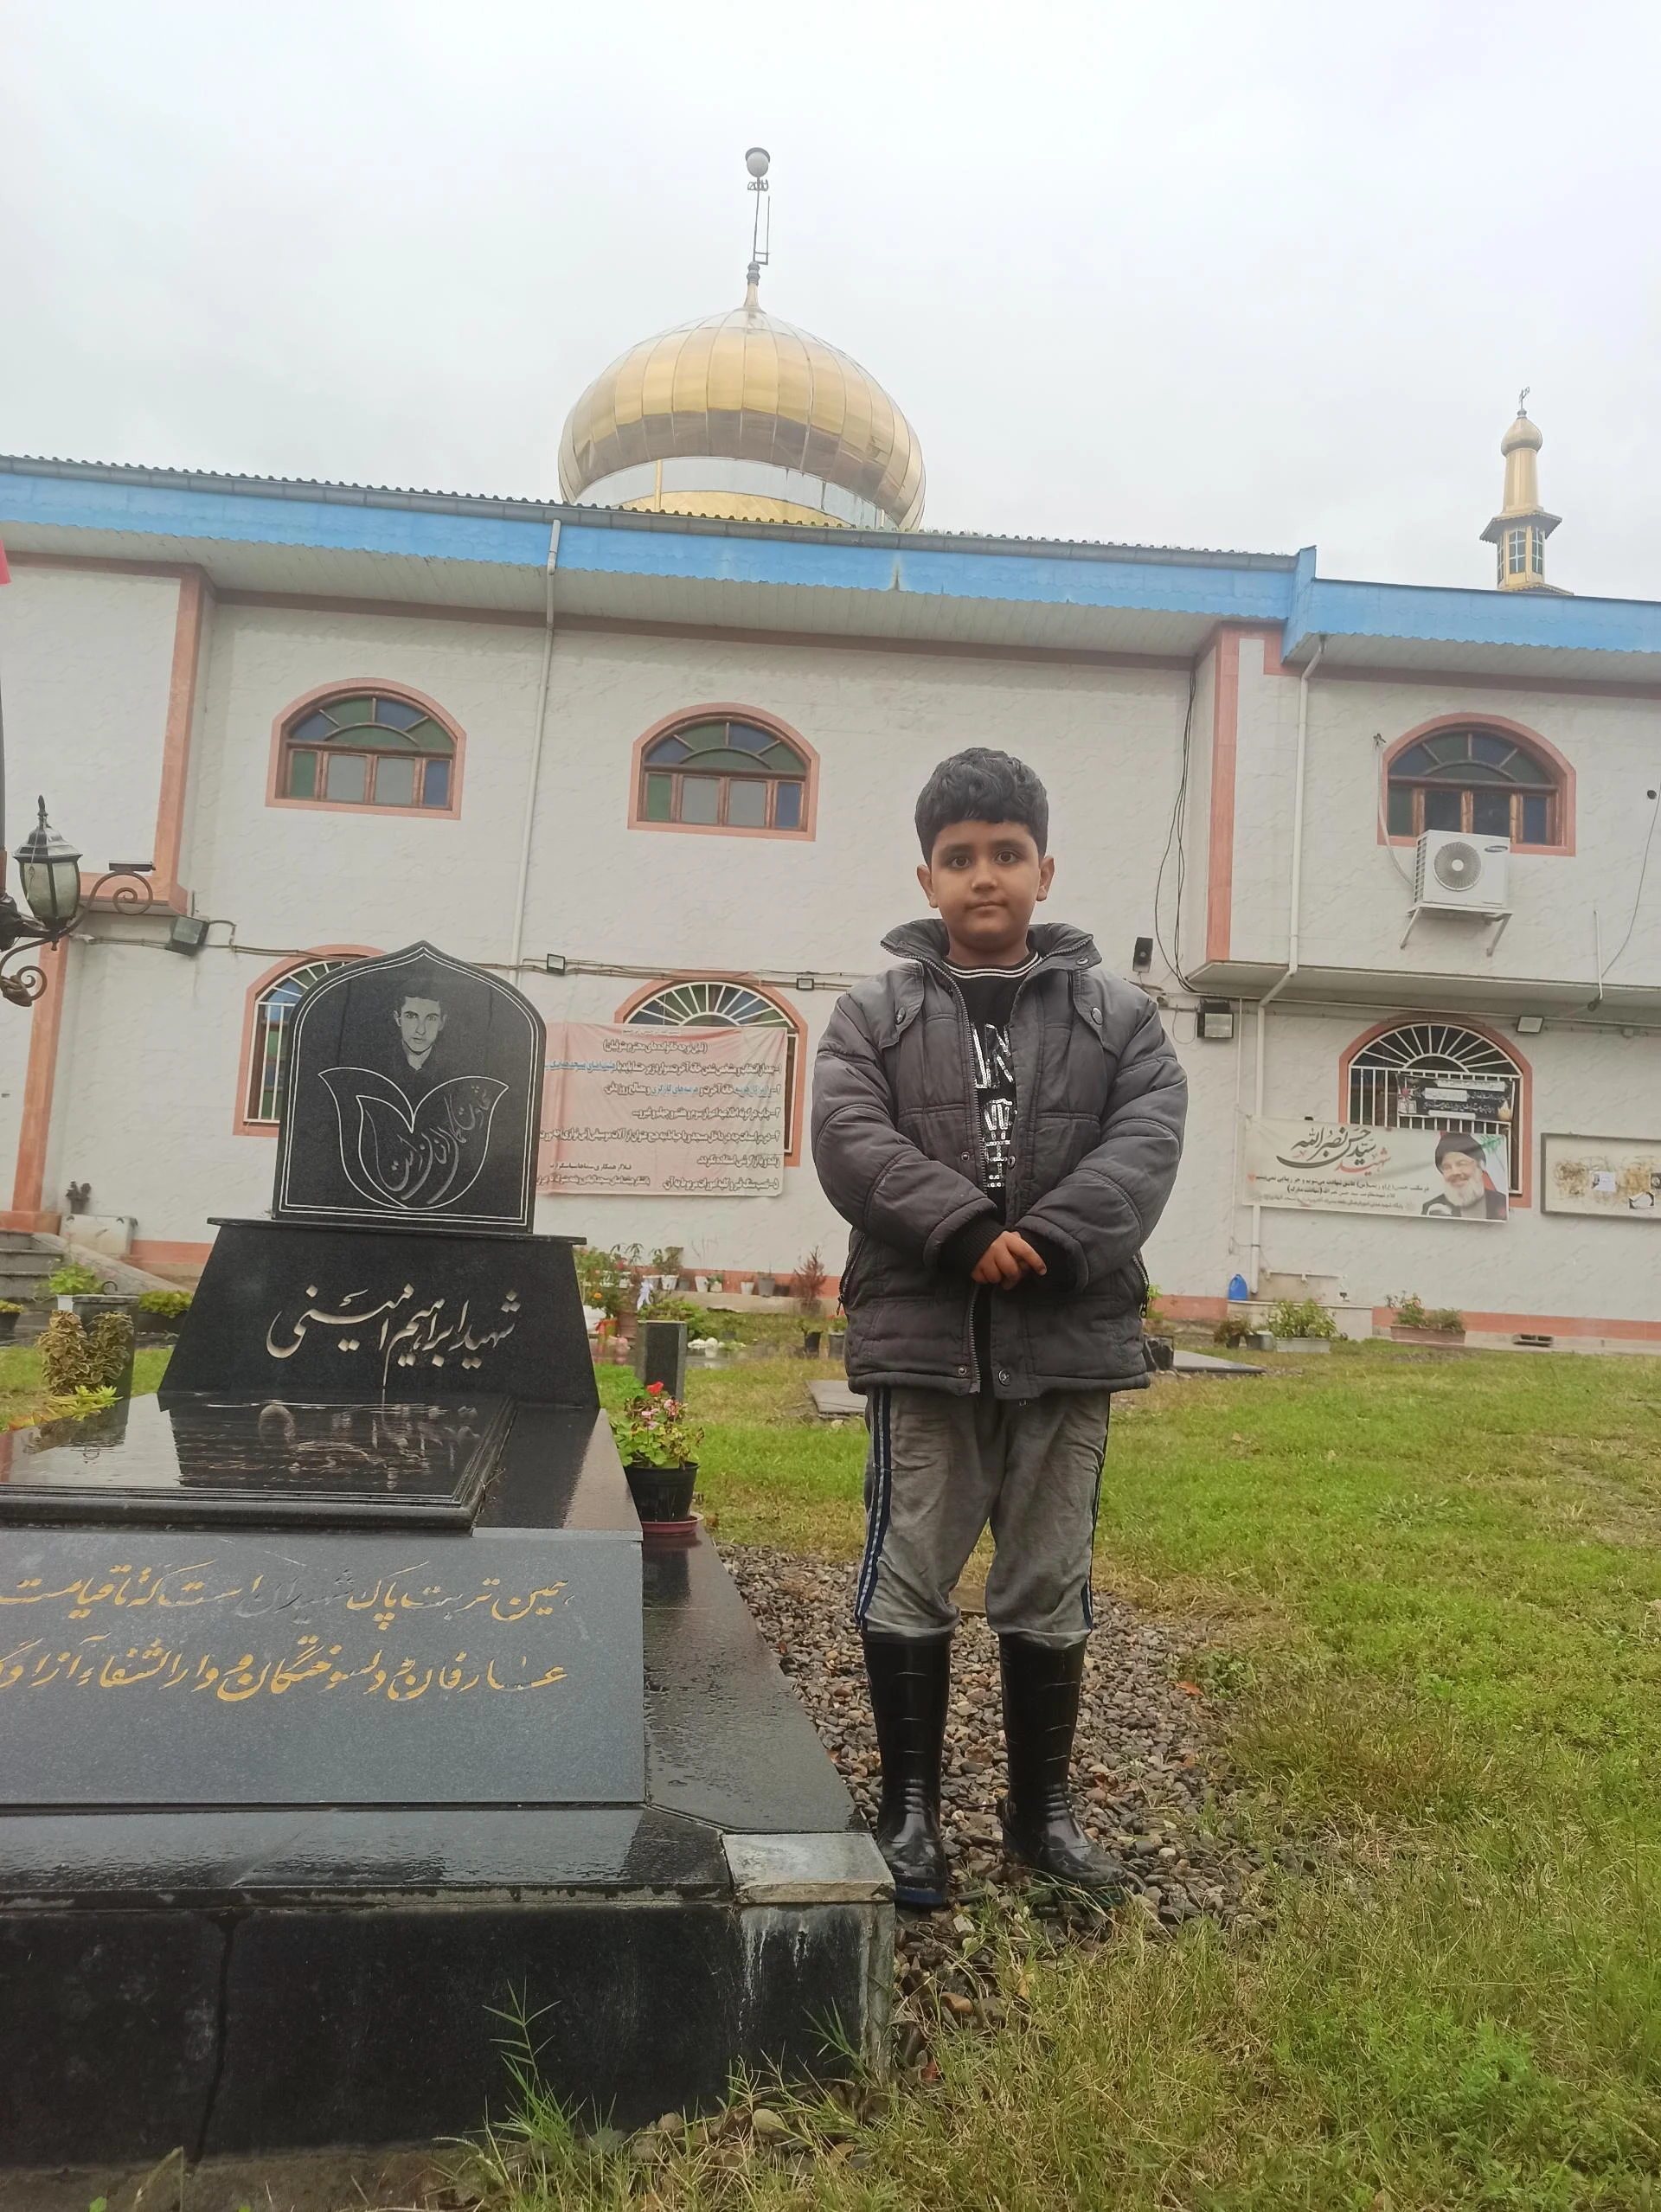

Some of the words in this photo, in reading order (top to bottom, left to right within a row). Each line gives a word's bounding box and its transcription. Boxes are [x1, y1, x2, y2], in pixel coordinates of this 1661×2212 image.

[1276, 1127, 1371, 1169] حسن
[1291, 1126, 1349, 1161] نصرالله
[1335, 1147, 1391, 1176] شهید
[1346, 1138, 1376, 1165] سید
[383, 1298, 469, 1386] ابراهیم
[448, 1289, 521, 1369] شهید
[127, 1560, 217, 1607] که
[158, 1574, 264, 1607] است
[234, 1569, 356, 1625] شهیدان
[346, 1560, 430, 1631] پاک
[401, 1577, 501, 1621] تربت
[491, 1579, 576, 1622] همین
[216, 1635, 387, 1702] دلسوختگان
[388, 1651, 568, 1702] عارفان
